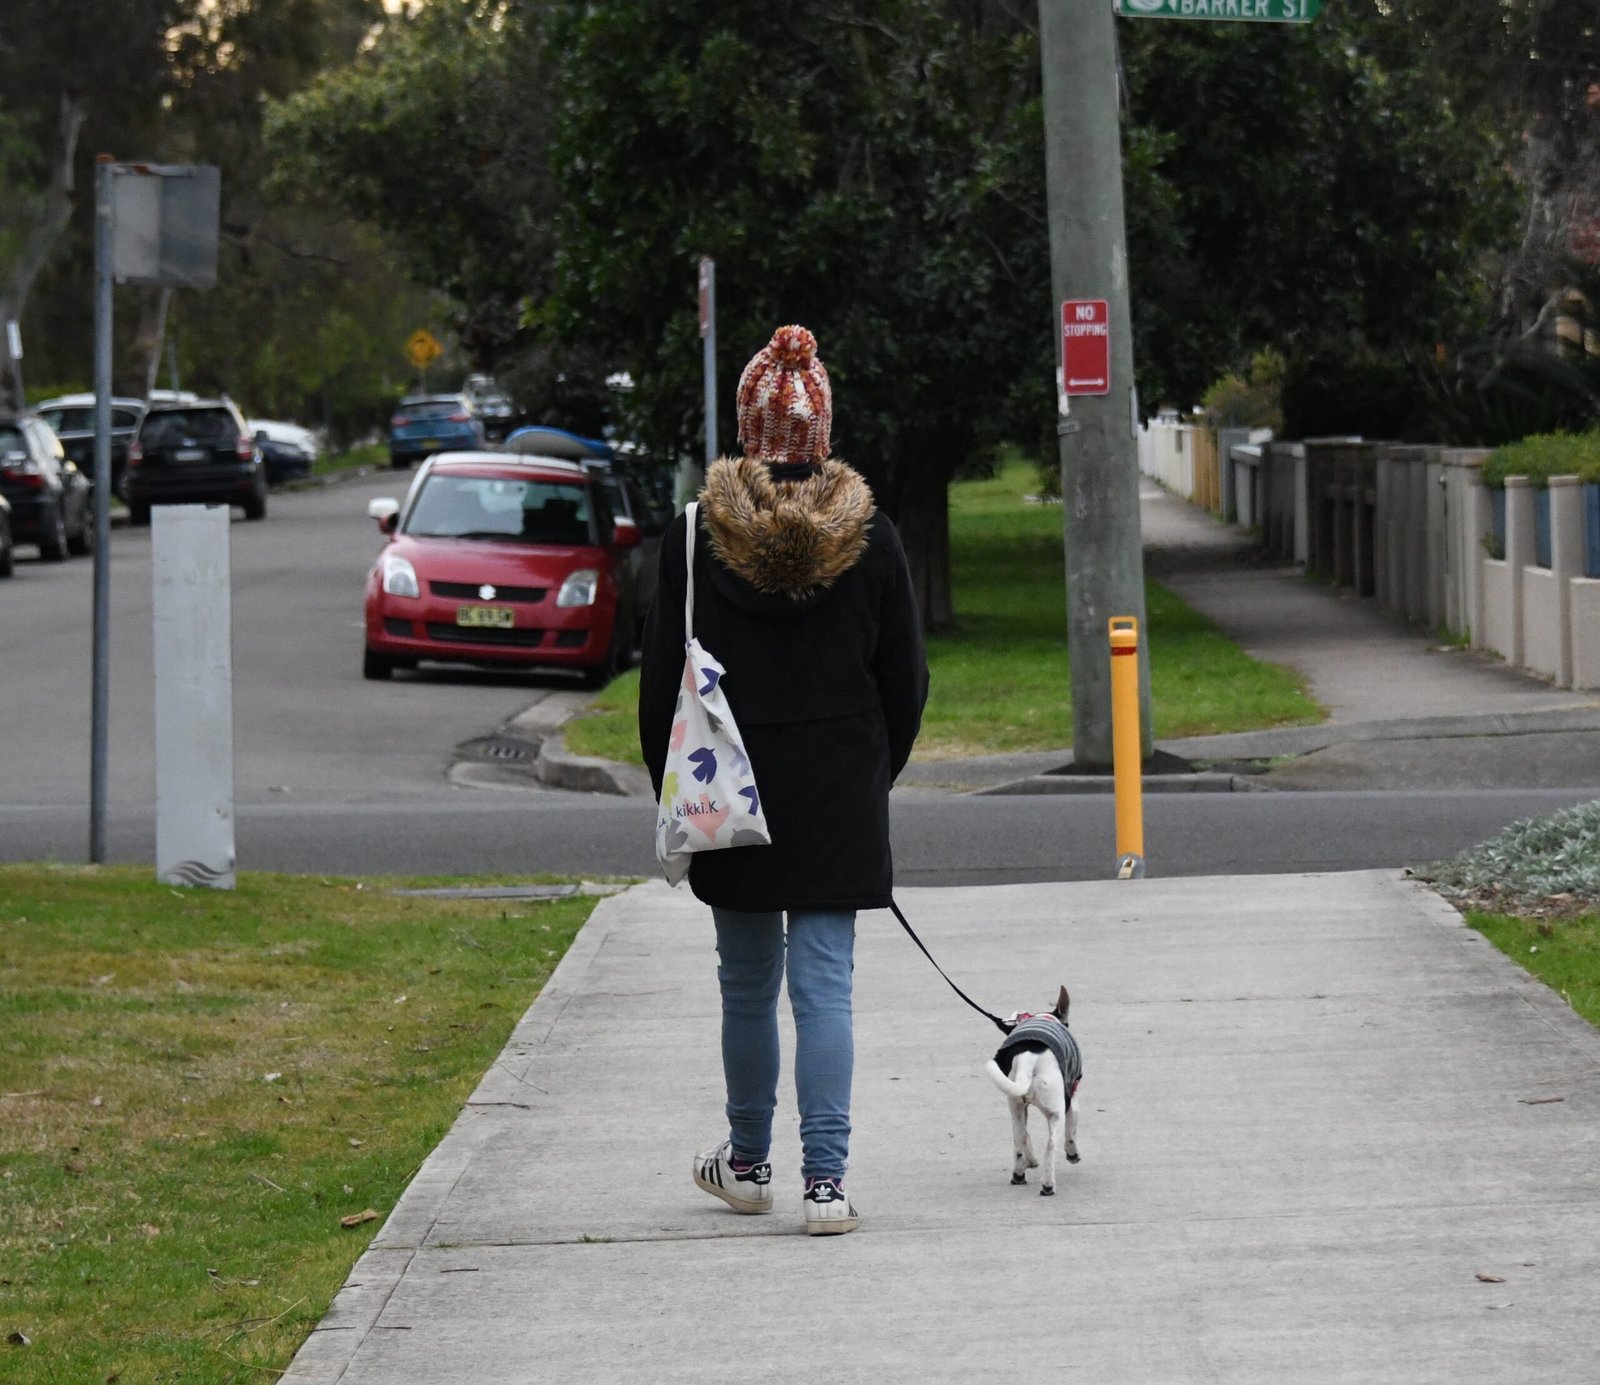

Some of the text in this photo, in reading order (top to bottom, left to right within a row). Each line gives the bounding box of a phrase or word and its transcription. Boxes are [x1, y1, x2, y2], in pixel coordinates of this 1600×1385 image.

[1180, 0, 1268, 17] BARKER
[1076, 304, 1094, 320] NO
[1064, 324, 1106, 337] STOPPING
[676, 801, 718, 818] kikki.K
